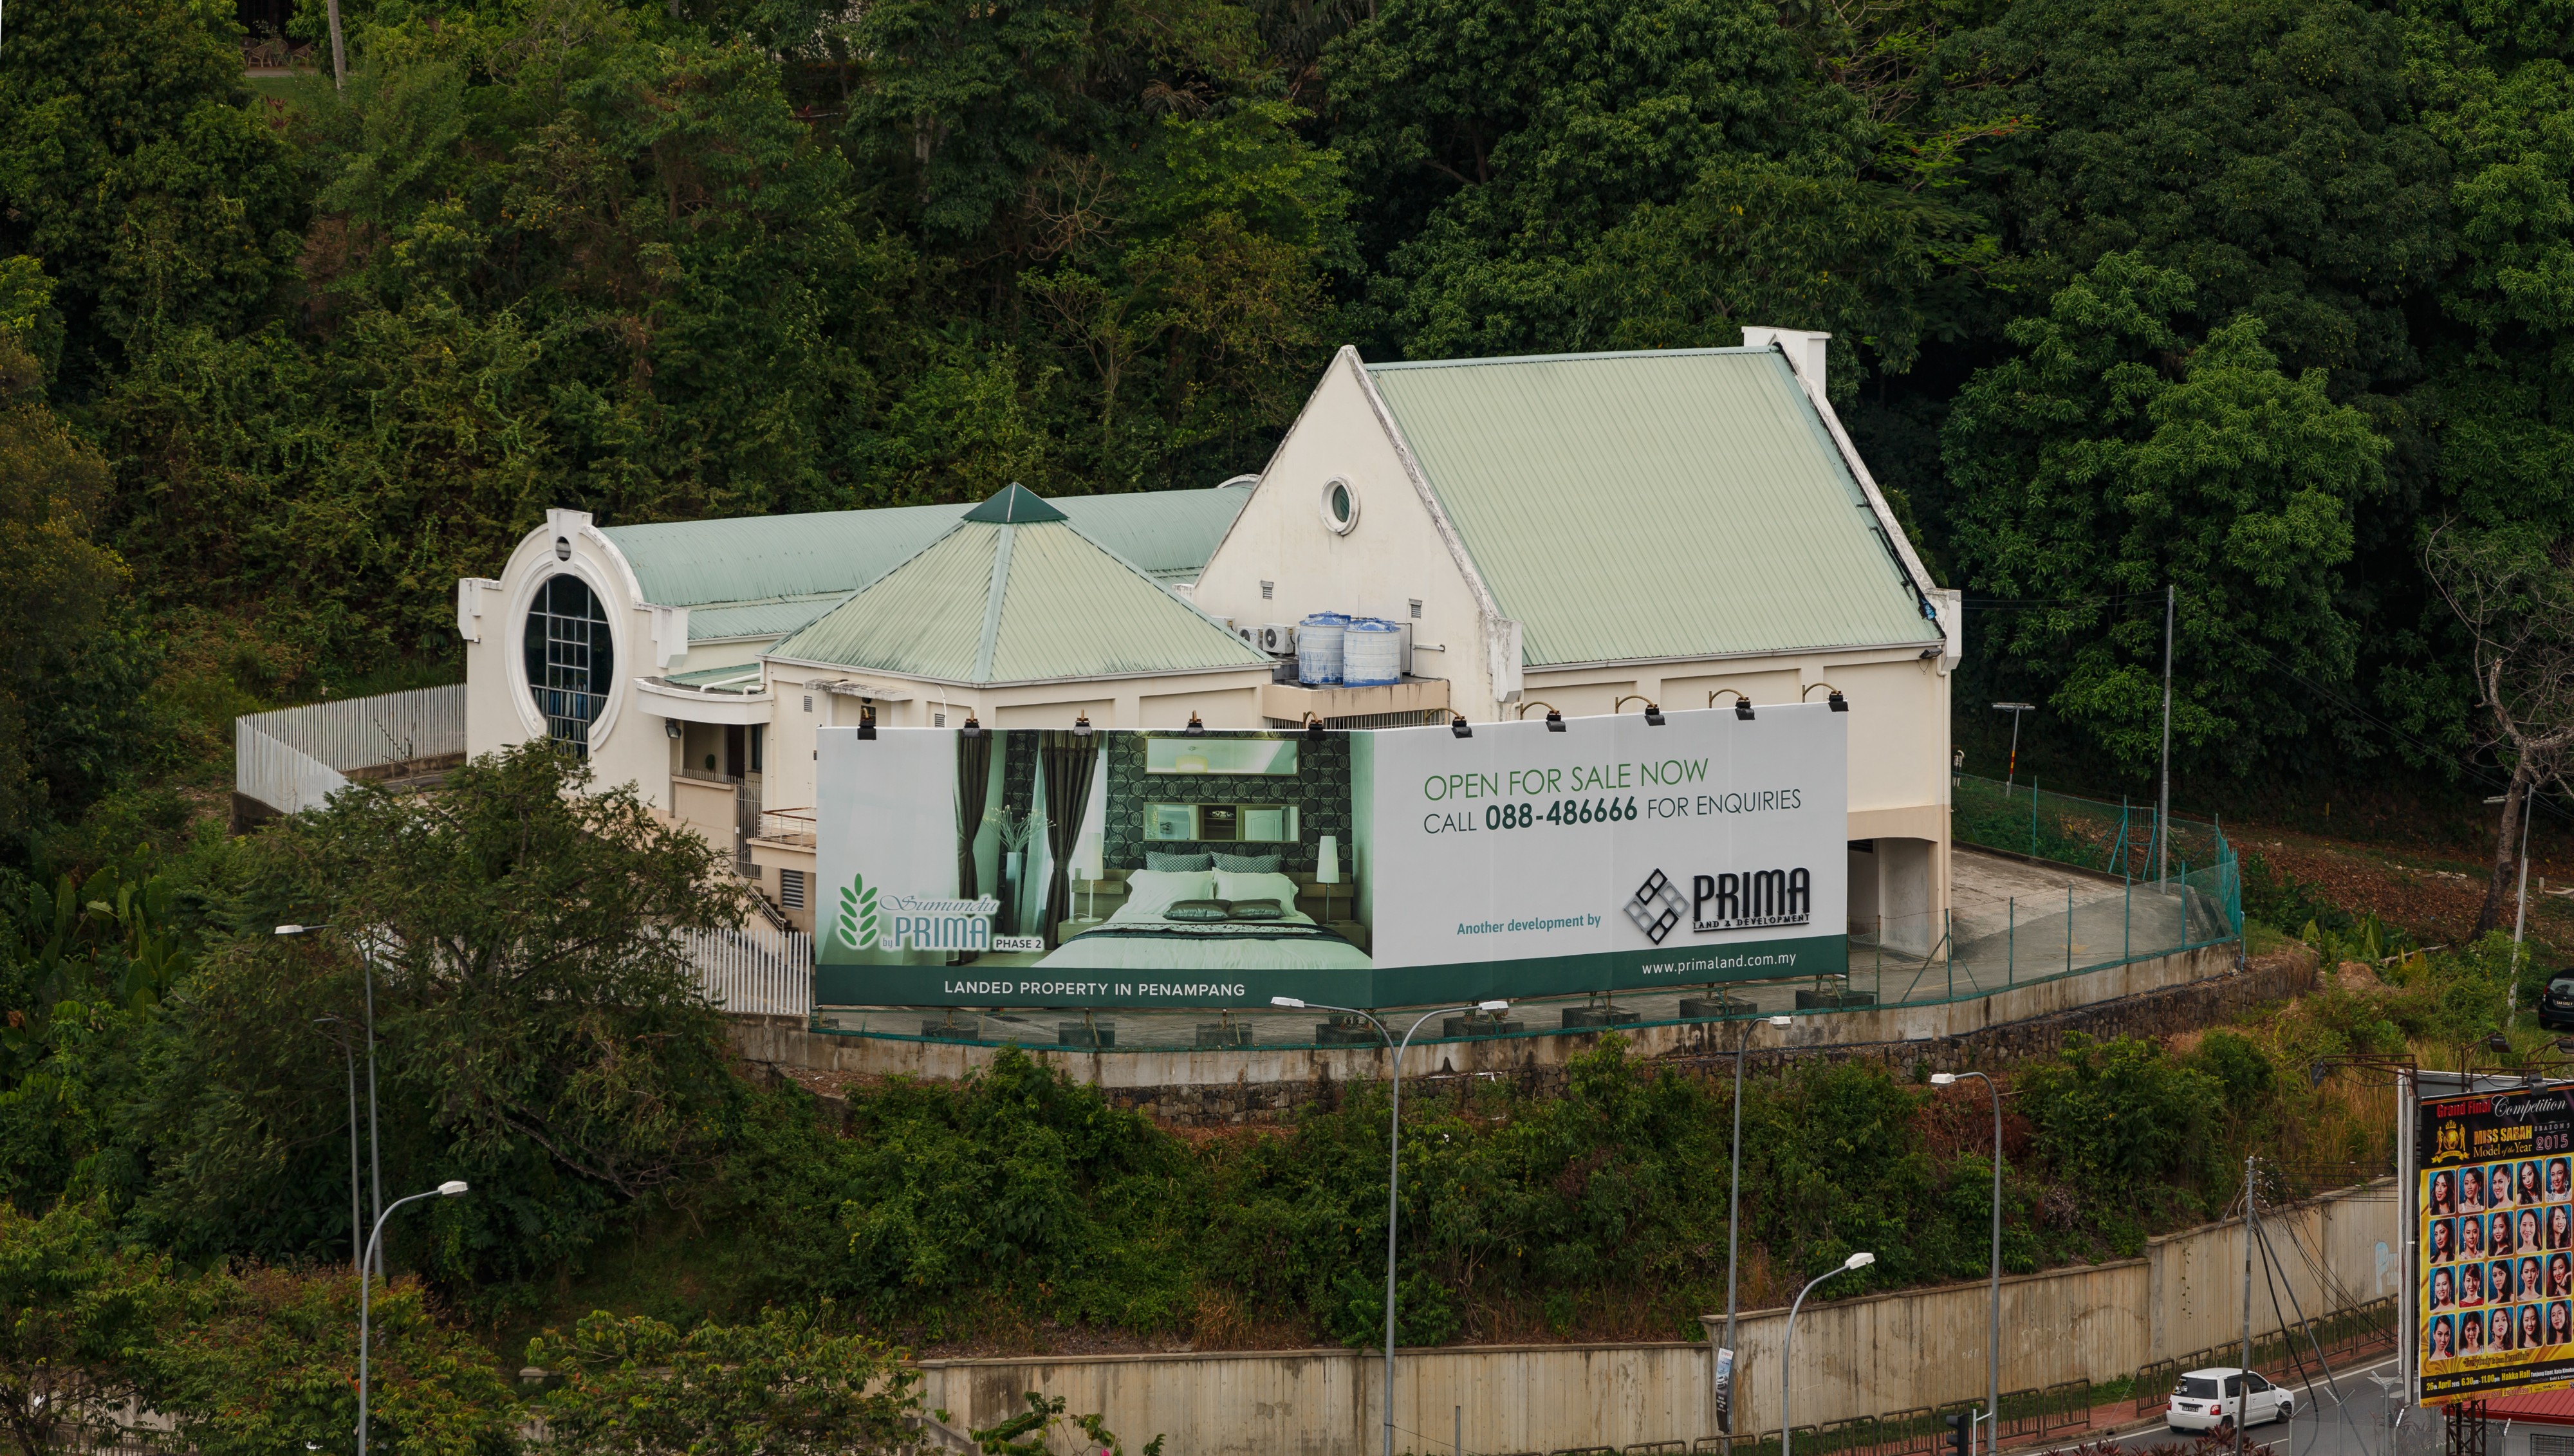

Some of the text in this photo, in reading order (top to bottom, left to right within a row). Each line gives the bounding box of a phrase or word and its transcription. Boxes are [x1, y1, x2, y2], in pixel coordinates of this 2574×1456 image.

[1424, 757, 1708, 801] OPEN FOR SALE NOW
[1423, 788, 1801, 834] CALL 088-486666 FOR ENQUIRIES
[880, 894, 997, 912] Sumundu
[1694, 867, 1810, 922] PRIMA
[1457, 912, 1602, 935] Another development by
[1693, 920, 1719, 930] LAND
[1737, 914, 1810, 926] DEVELOPMENT
[882, 916, 987, 949] by PRIMA
[995, 939, 1042, 948] PHASE 2
[1642, 953, 1797, 975] www.primaland.com.my
[945, 981, 1246, 997] LANDED PROPERTY IN PENAMPANG
[2436, 1094, 2568, 1121] Grand Final Competition
[2474, 1125, 2533, 1145] MISS SABAH
[2534, 1123, 2564, 1132] SEASON
[2474, 1143, 2501, 1157] Model
[2501, 1146, 2508, 1157] of
[2514, 1141, 2533, 1153] Year
[2536, 1133, 2568, 1151] 2015
[2438, 1379, 2451, 1389] April
[2501, 1372, 2519, 1381] Hakka
[2519, 1369, 2530, 1378] Hall
